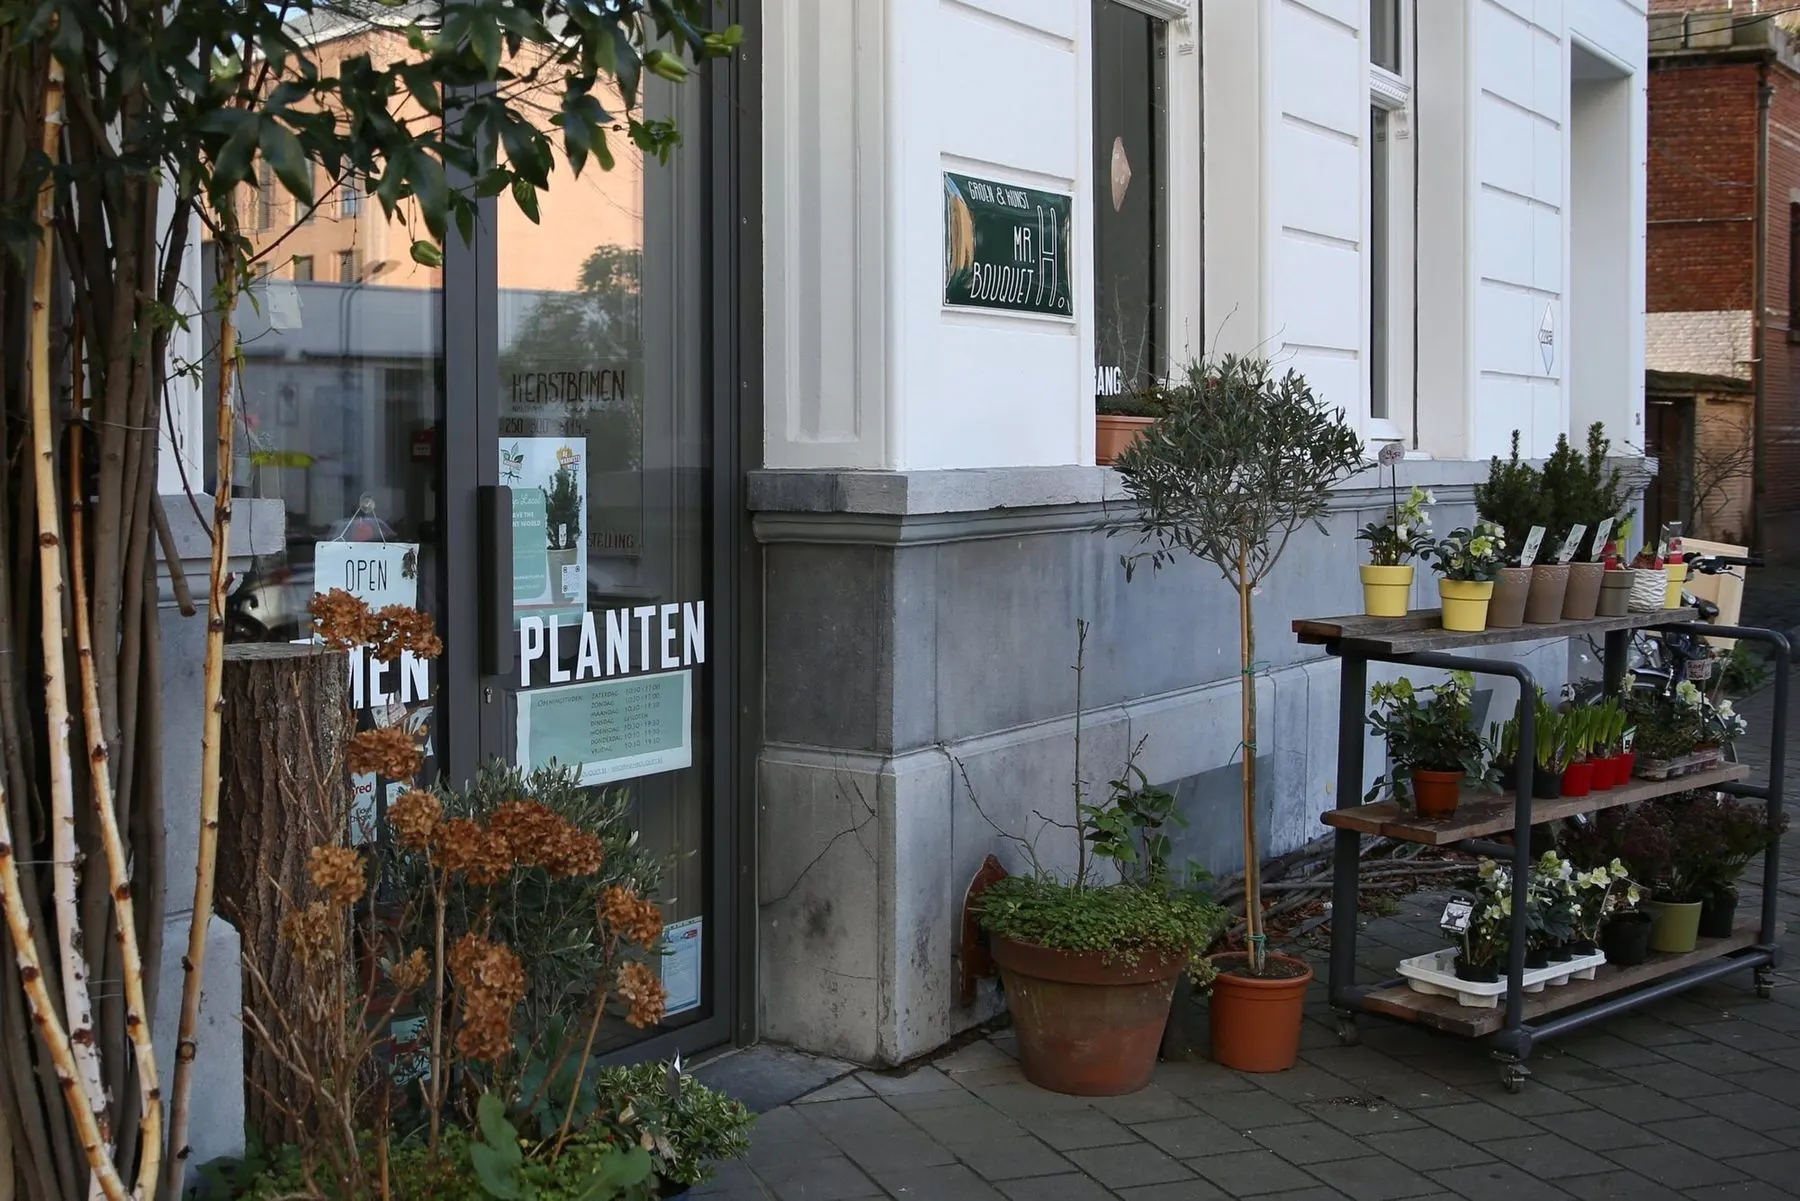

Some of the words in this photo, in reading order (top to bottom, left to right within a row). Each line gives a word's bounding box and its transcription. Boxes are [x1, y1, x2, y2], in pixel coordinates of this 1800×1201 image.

[967, 181, 995, 203] GROEN
[996, 187, 1006, 206] &
[1013, 225, 1036, 264] MR.
[970, 262, 1034, 305] BOUQUET
[512, 368, 626, 405] KERSTBOMEN
[1095, 366, 1121, 396] ANG
[345, 559, 387, 592] OPEN
[520, 600, 705, 687] PLANTEN
